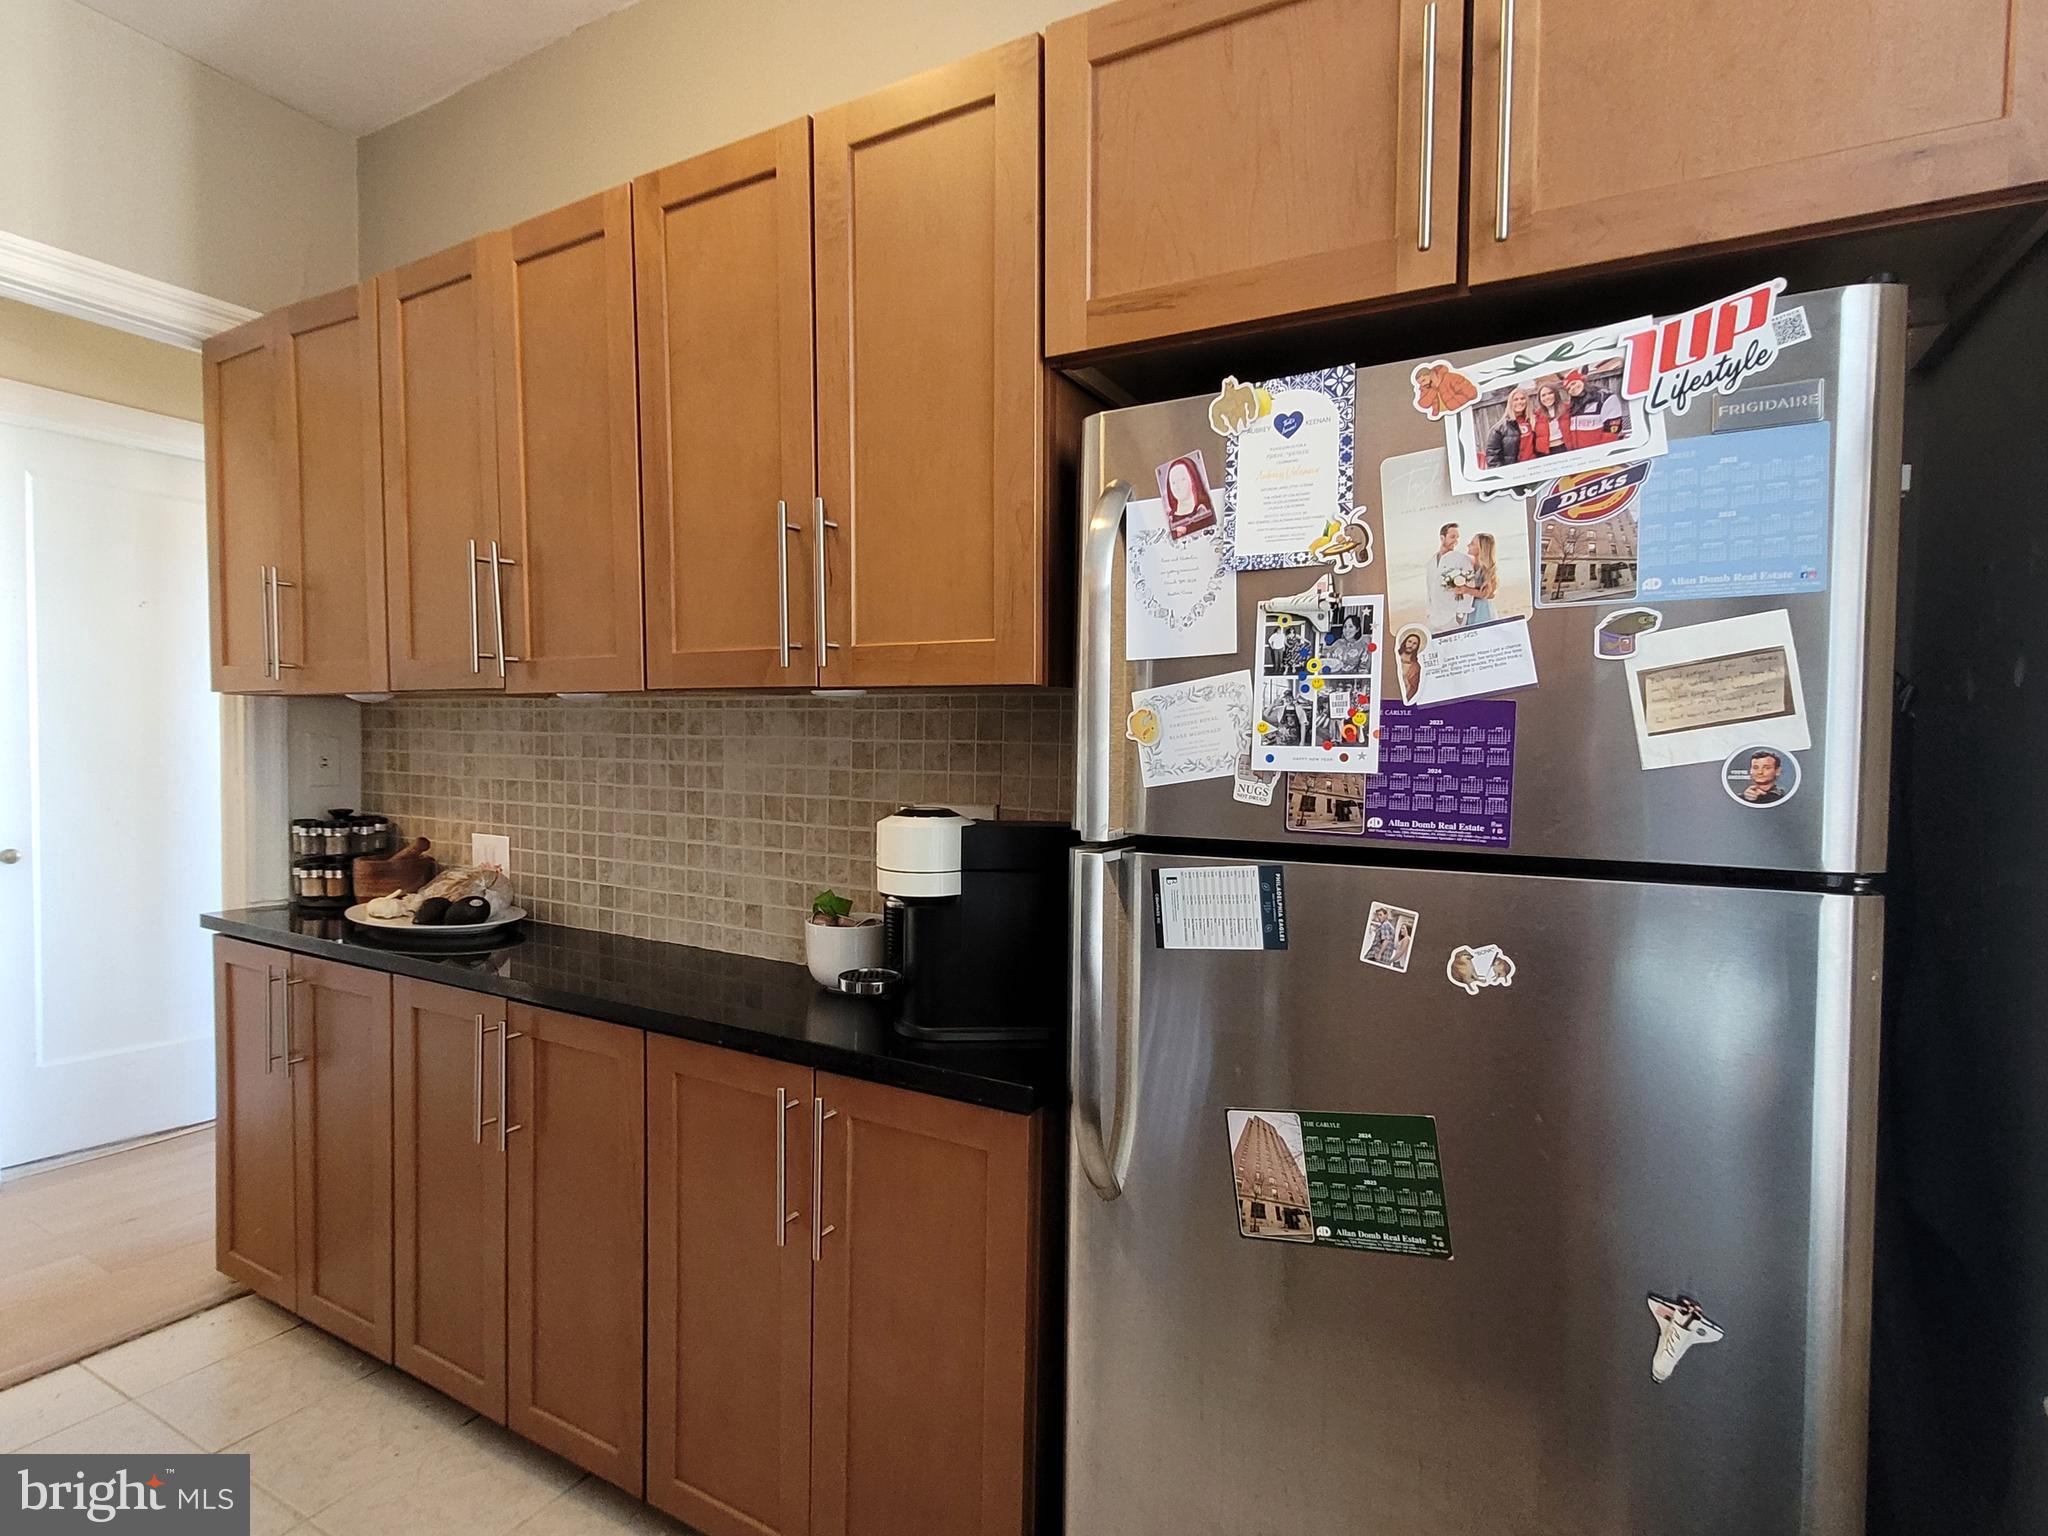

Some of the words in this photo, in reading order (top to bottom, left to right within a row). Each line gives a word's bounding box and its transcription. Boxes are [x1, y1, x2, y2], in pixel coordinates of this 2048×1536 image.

[1624, 287, 1771, 395] 1UP
[1651, 339, 1773, 410] Lifestyle
[1719, 393, 1819, 417] FRIGIDAIRE
[1557, 474, 1628, 508] Dicks
[1734, 572, 1757, 581] Real
[1760, 570, 1793, 580] Estate
[1238, 783, 1269, 797] NUGS
[1388, 819, 1410, 827] Allan
[1412, 820, 1434, 829] Domb
[1438, 821, 1457, 830] Real
[1459, 823, 1485, 832] Estate
[1336, 1228, 1356, 1237] Allan
[1358, 1230, 1381, 1240] Domb
[1383, 1232, 1401, 1241] Real
[1402, 1234, 1427, 1245] Estate
